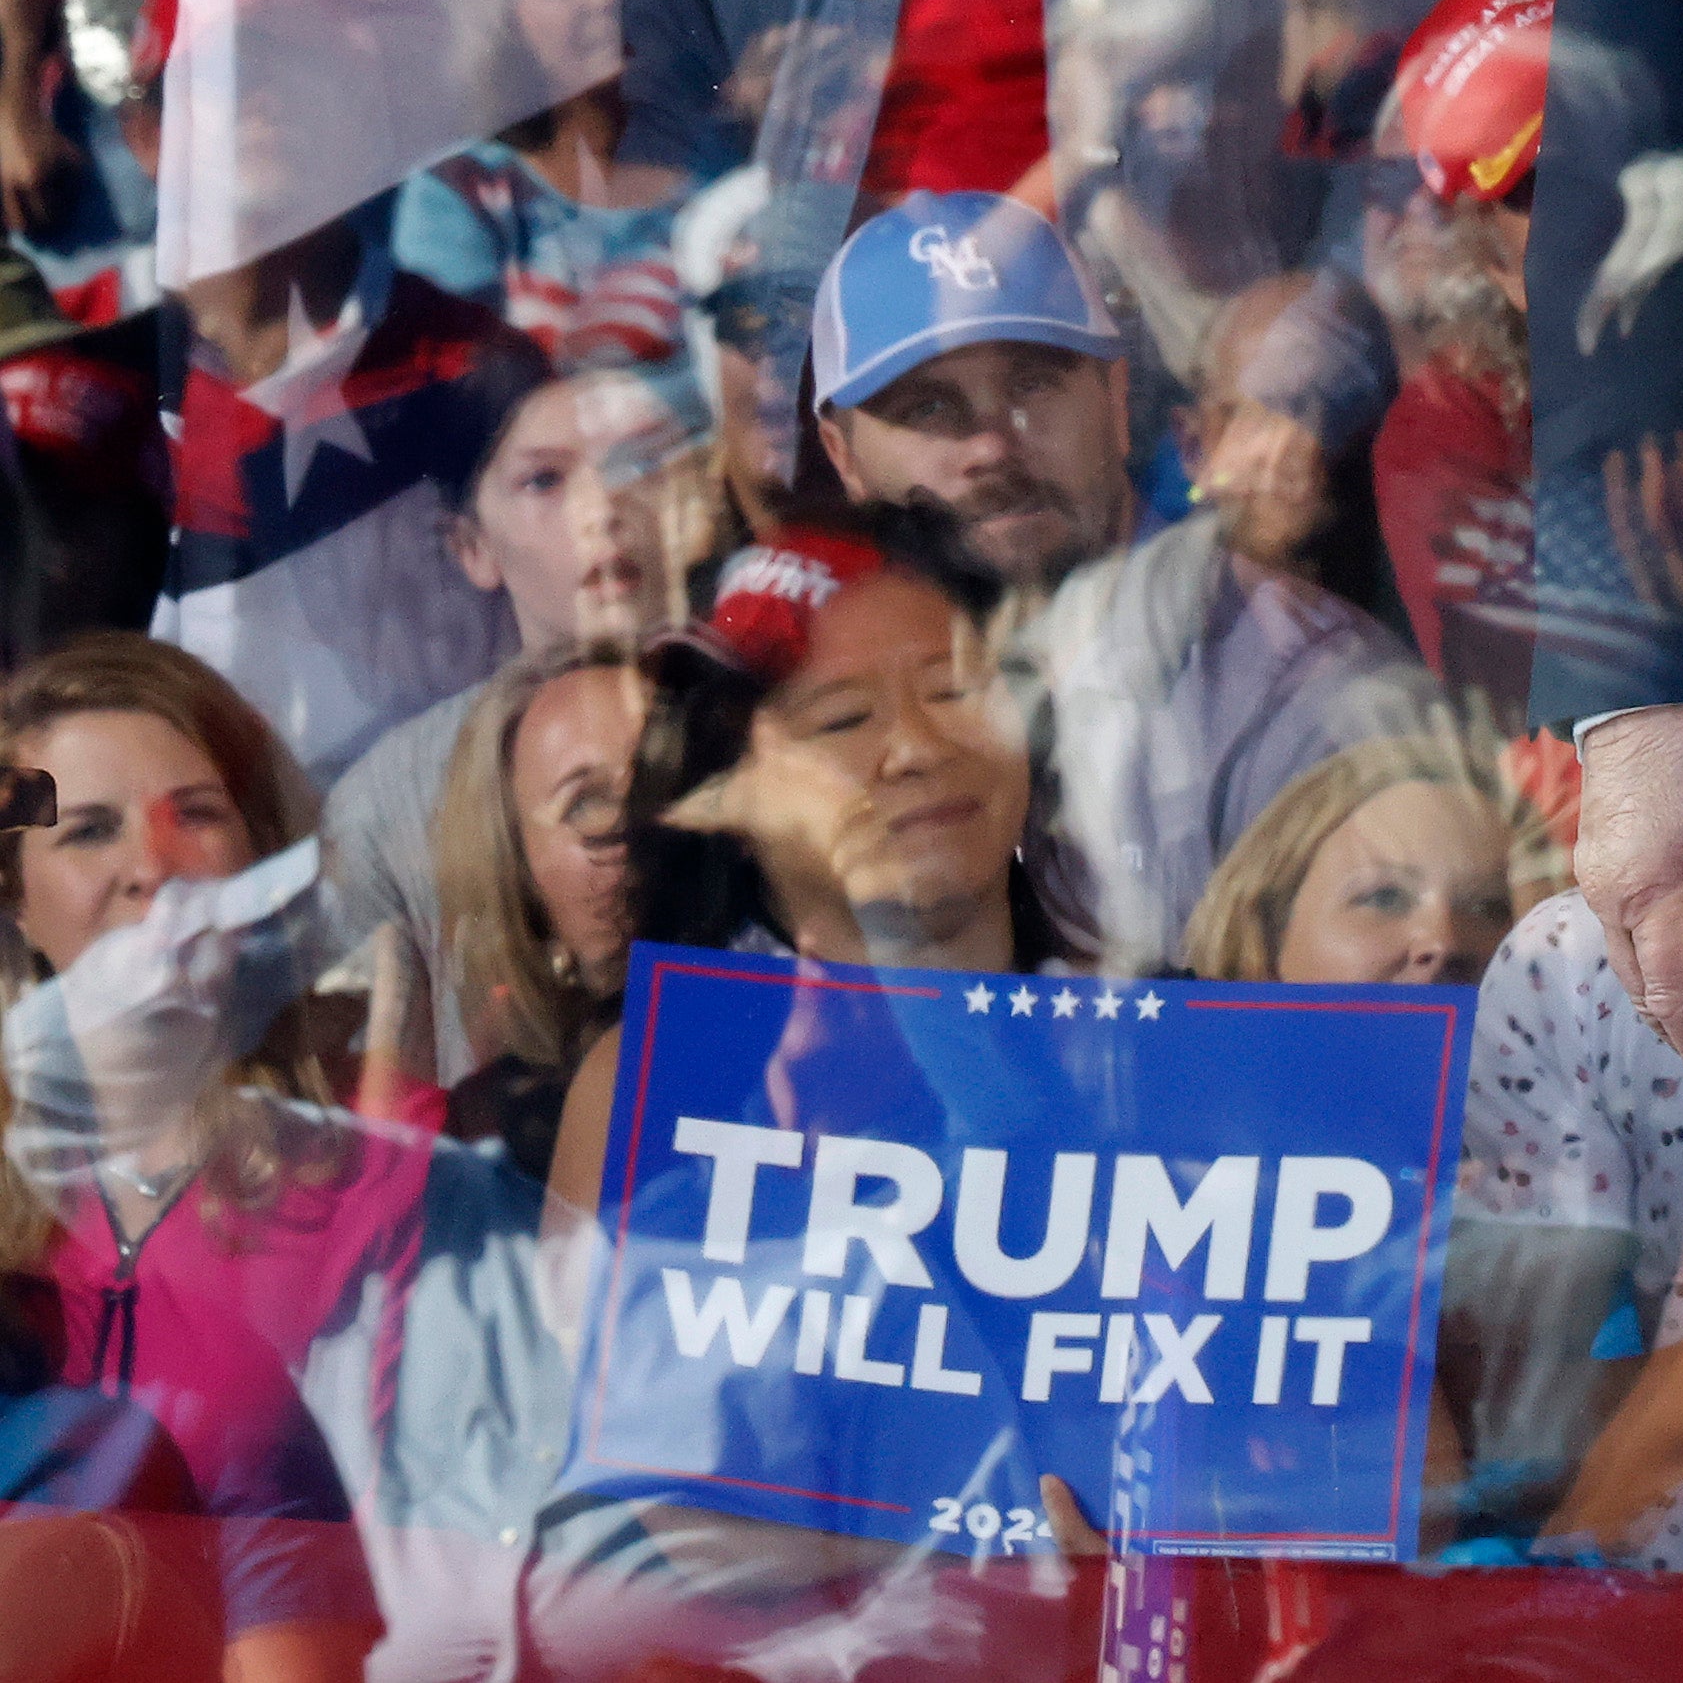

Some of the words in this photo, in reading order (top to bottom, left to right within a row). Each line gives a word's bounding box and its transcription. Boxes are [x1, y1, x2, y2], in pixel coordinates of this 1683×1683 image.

[672, 1116, 1393, 1302] TRUMP
[661, 1268, 982, 1396] WILL
[1021, 1311, 1223, 1405] FIX
[1252, 1315, 1373, 1406] IT
